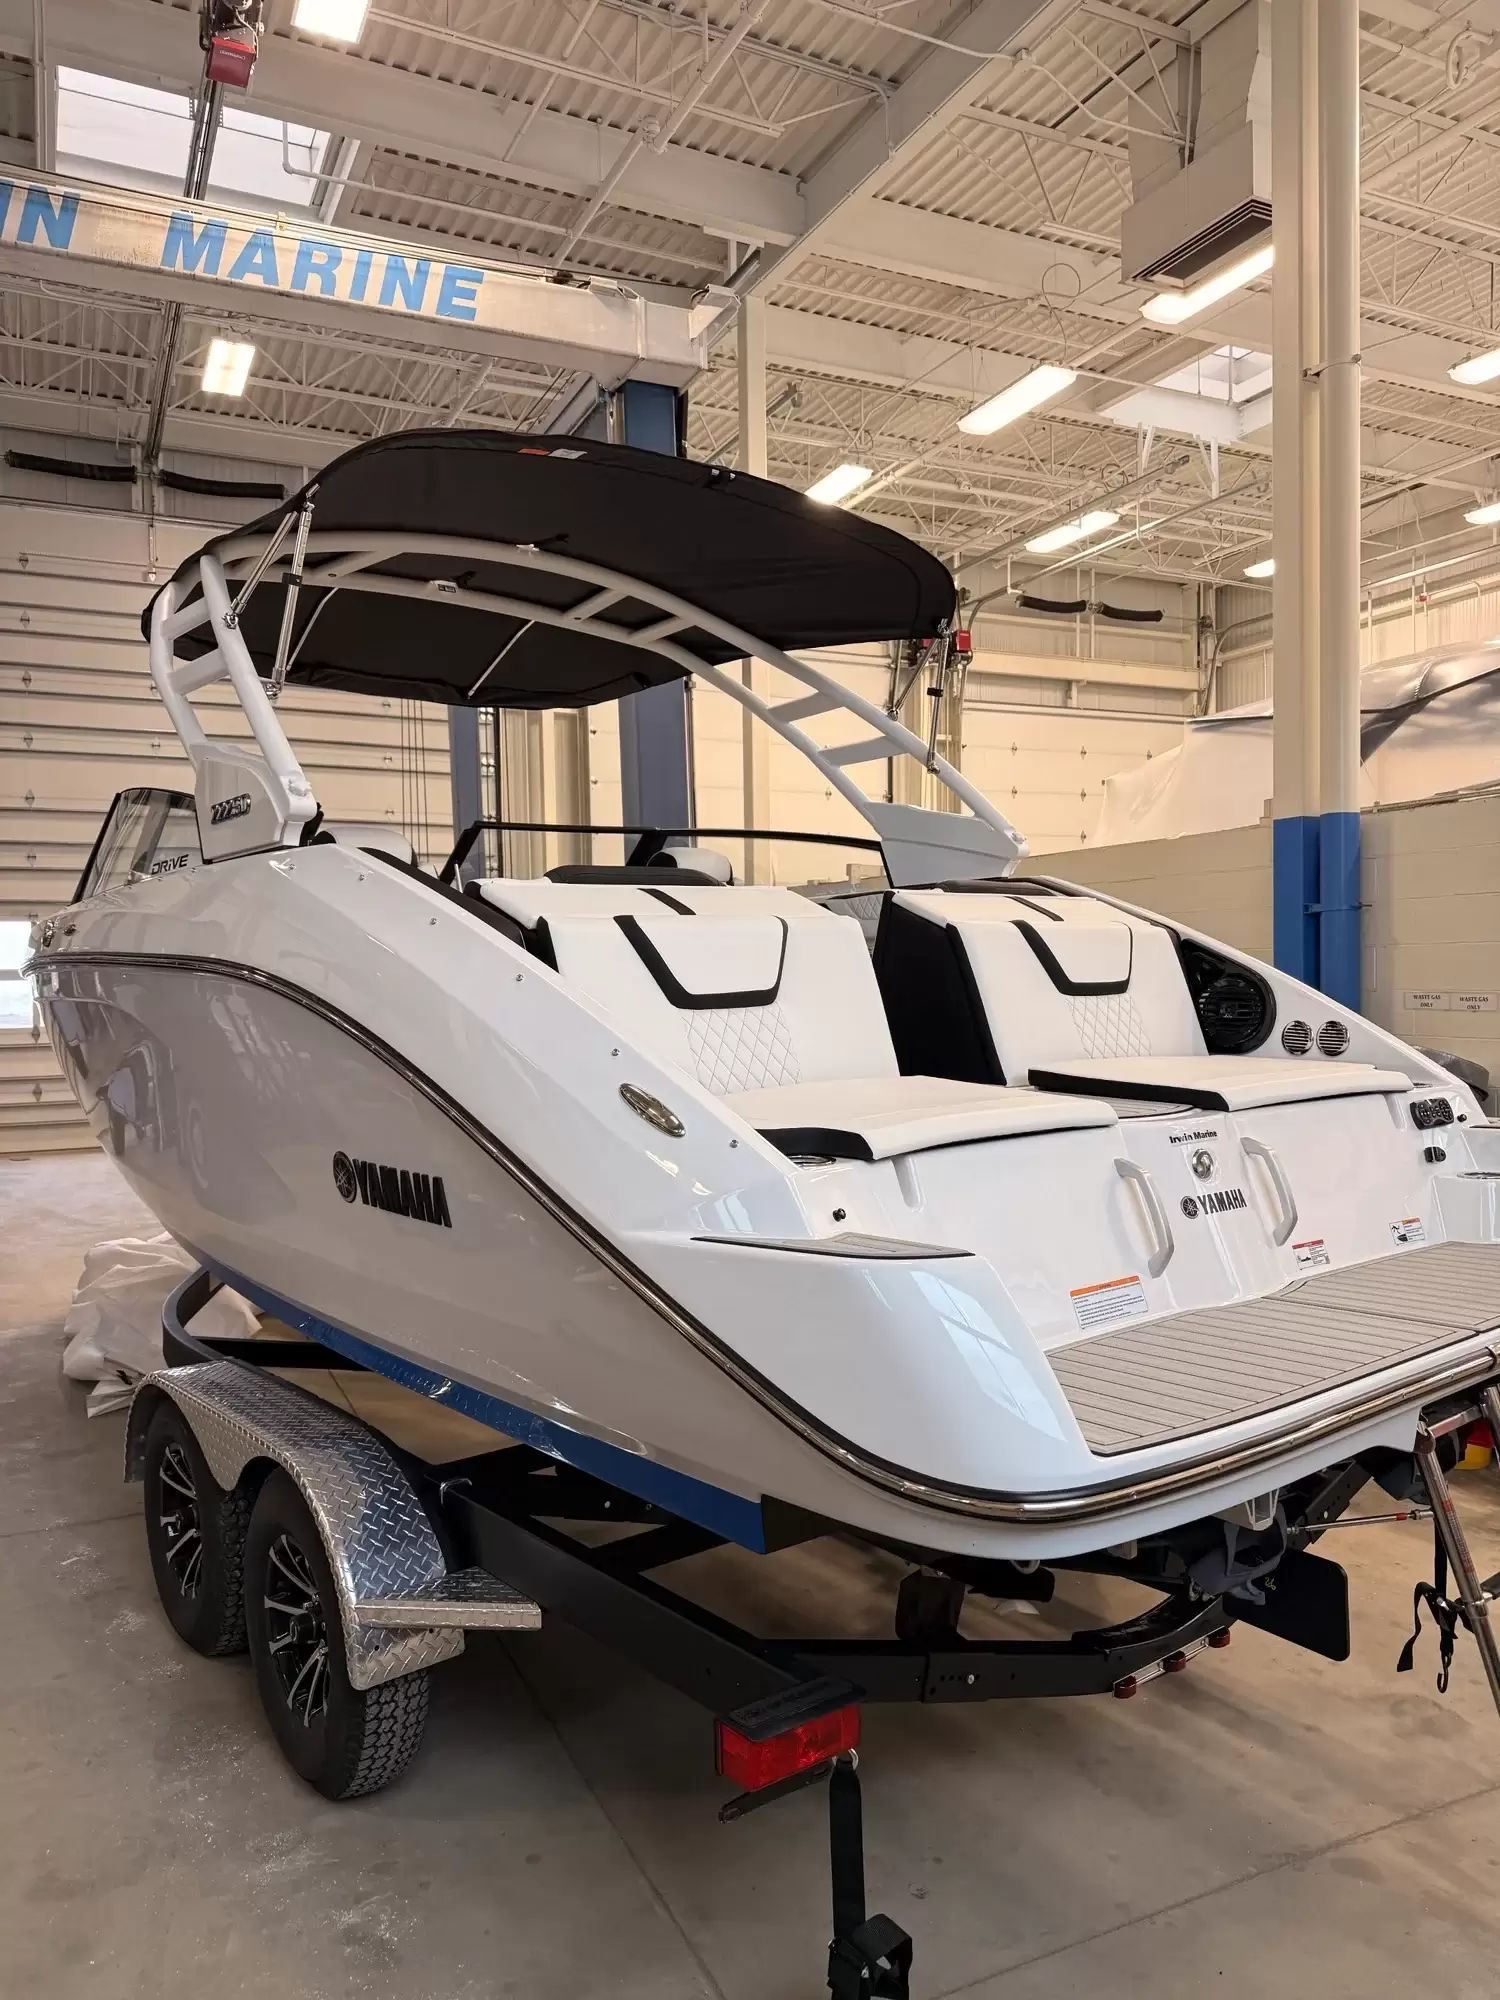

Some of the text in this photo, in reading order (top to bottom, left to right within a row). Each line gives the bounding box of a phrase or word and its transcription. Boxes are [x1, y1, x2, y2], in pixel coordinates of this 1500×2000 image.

[159, 209, 485, 321] MARINE
[1169, 1129, 1218, 1144] Irwin Marine
[352, 1158, 453, 1229] YAMAHA
[1197, 1188, 1248, 1215] YAMAHA
